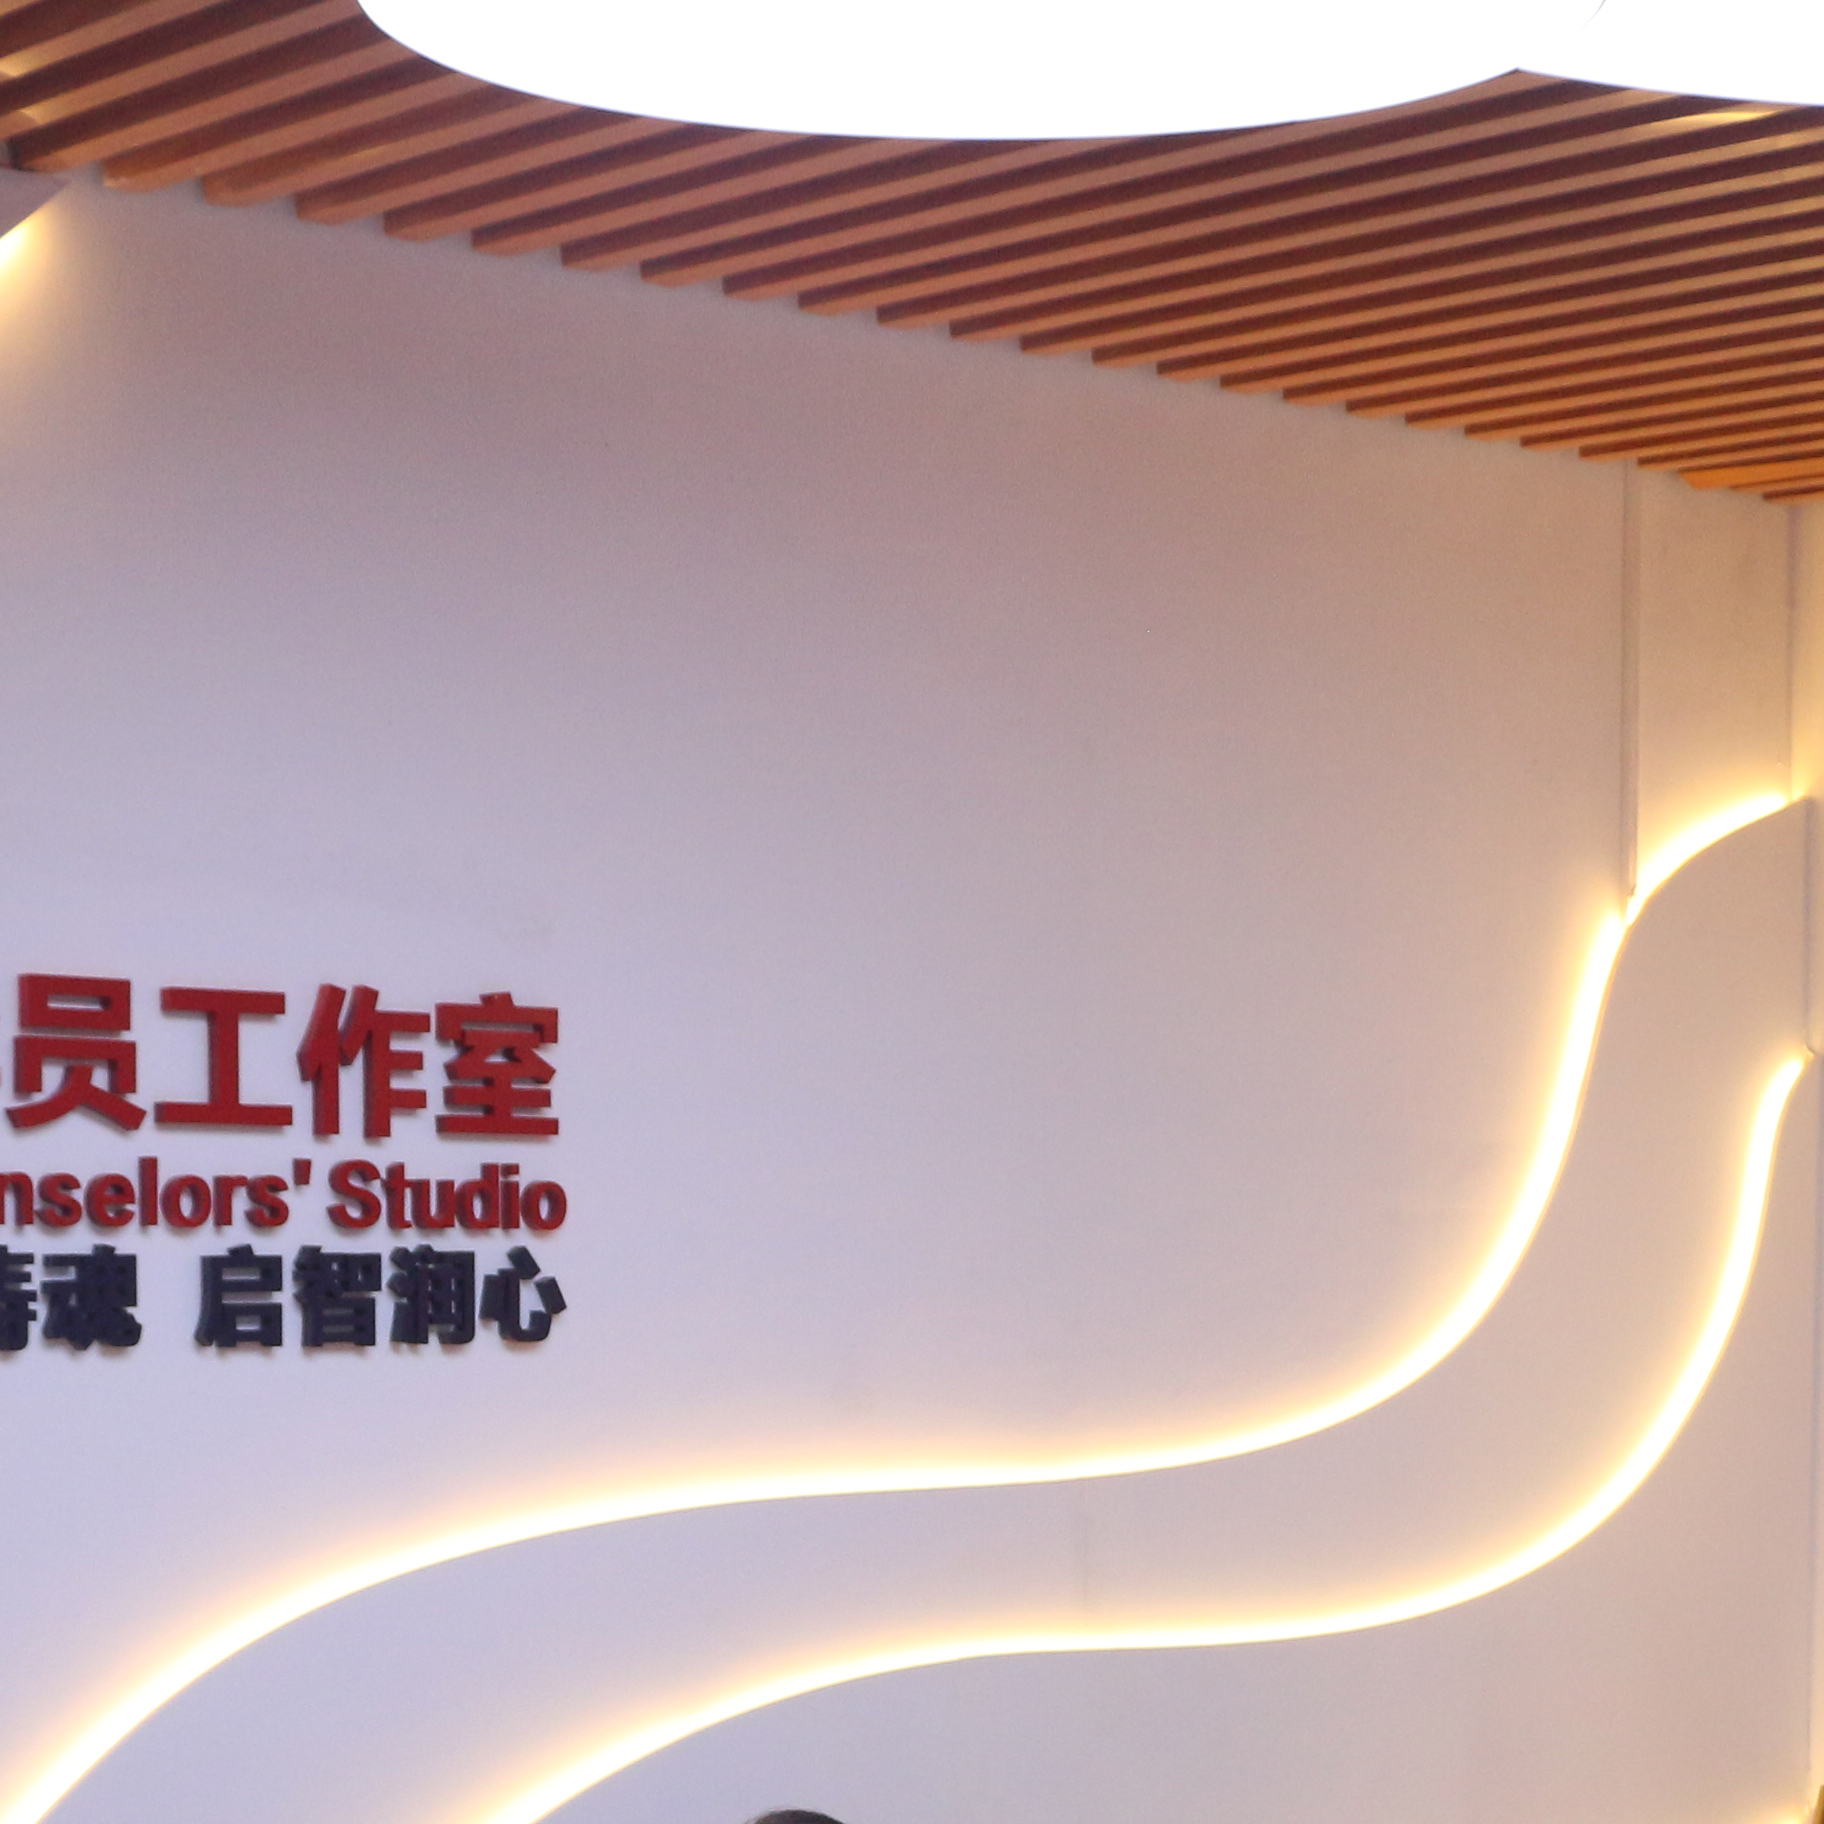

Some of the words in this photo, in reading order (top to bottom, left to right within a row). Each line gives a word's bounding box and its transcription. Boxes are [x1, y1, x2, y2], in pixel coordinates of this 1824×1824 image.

[329, 1159, 568, 1233] Studio
[193, 1243, 568, 1350] 启智润心
